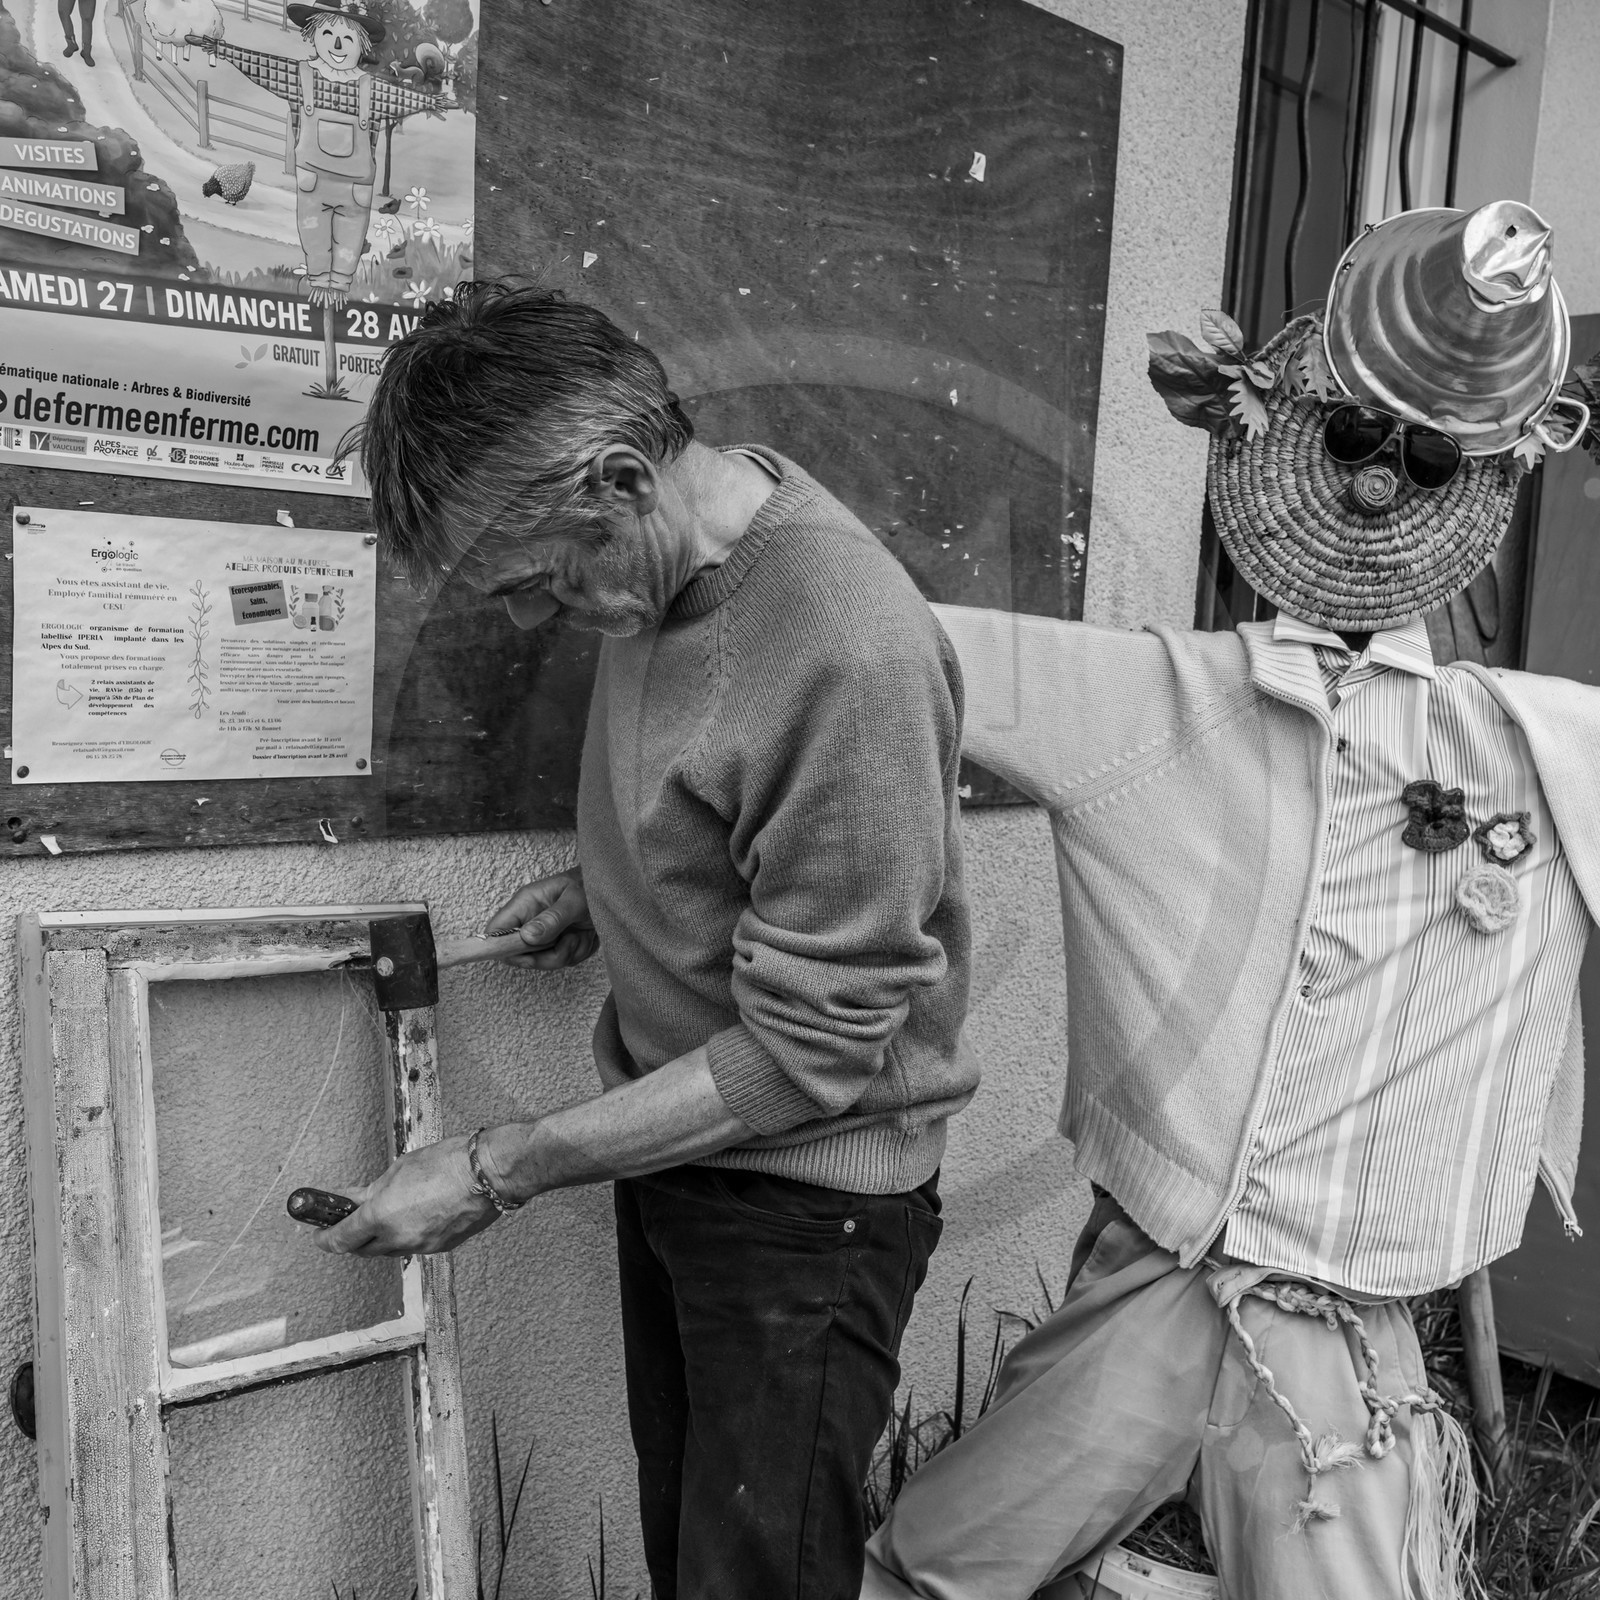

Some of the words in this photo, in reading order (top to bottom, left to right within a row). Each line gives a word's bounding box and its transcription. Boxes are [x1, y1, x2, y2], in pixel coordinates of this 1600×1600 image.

[14, 143, 85, 164] VISITES
[1, 175, 117, 207] ANIMATIONS
[0, 204, 136, 249] DEGUSTATIONS
[97, 281, 134, 312] 27
[165, 288, 313, 332] DIMANCHE
[346, 309, 380, 339] 28
[388, 313, 420, 341] AV
[273, 344, 320, 367] GRATUIT
[339, 354, 382, 376] PORTES
[62, 374, 119, 390] nationale
[131, 381, 169, 396] Arbres
[173, 386, 182, 398] &
[186, 387, 251, 407] Biodiversité
[14, 388, 319, 452] defermeenferme.com
[52, 443, 85, 453] VAUCLUSE
[94, 439, 121, 448] ALPES
[93, 446, 139, 456] PROVENCE
[189, 454, 219, 462] BOUCHES
[91, 549, 139, 561] Ergologic
[225, 562, 260, 573] ATELIER
[262, 564, 302, 575] PRODUITS
[304, 566, 354, 578] D'ENTRETIEN
[56, 577, 78, 586] Vous
[80, 578, 100, 587] êtes
[101, 580, 141, 589] assistant
[48, 589, 85, 599] Employé
[88, 590, 122, 599] familial
[124, 592, 165, 601] rémunéré
[89, 625, 129, 634] organisme
[148, 626, 184, 634] formation
[77, 633, 103, 641] IPERIA
[114, 635, 147, 643] implanté
[40, 643, 61, 651] Alpes
[74, 643, 91, 651] Sud.
[60, 653, 79, 661] Vous
[80, 654, 110, 662] propose
[61, 663, 102, 671] totalement
[104, 664, 127, 672] prises
